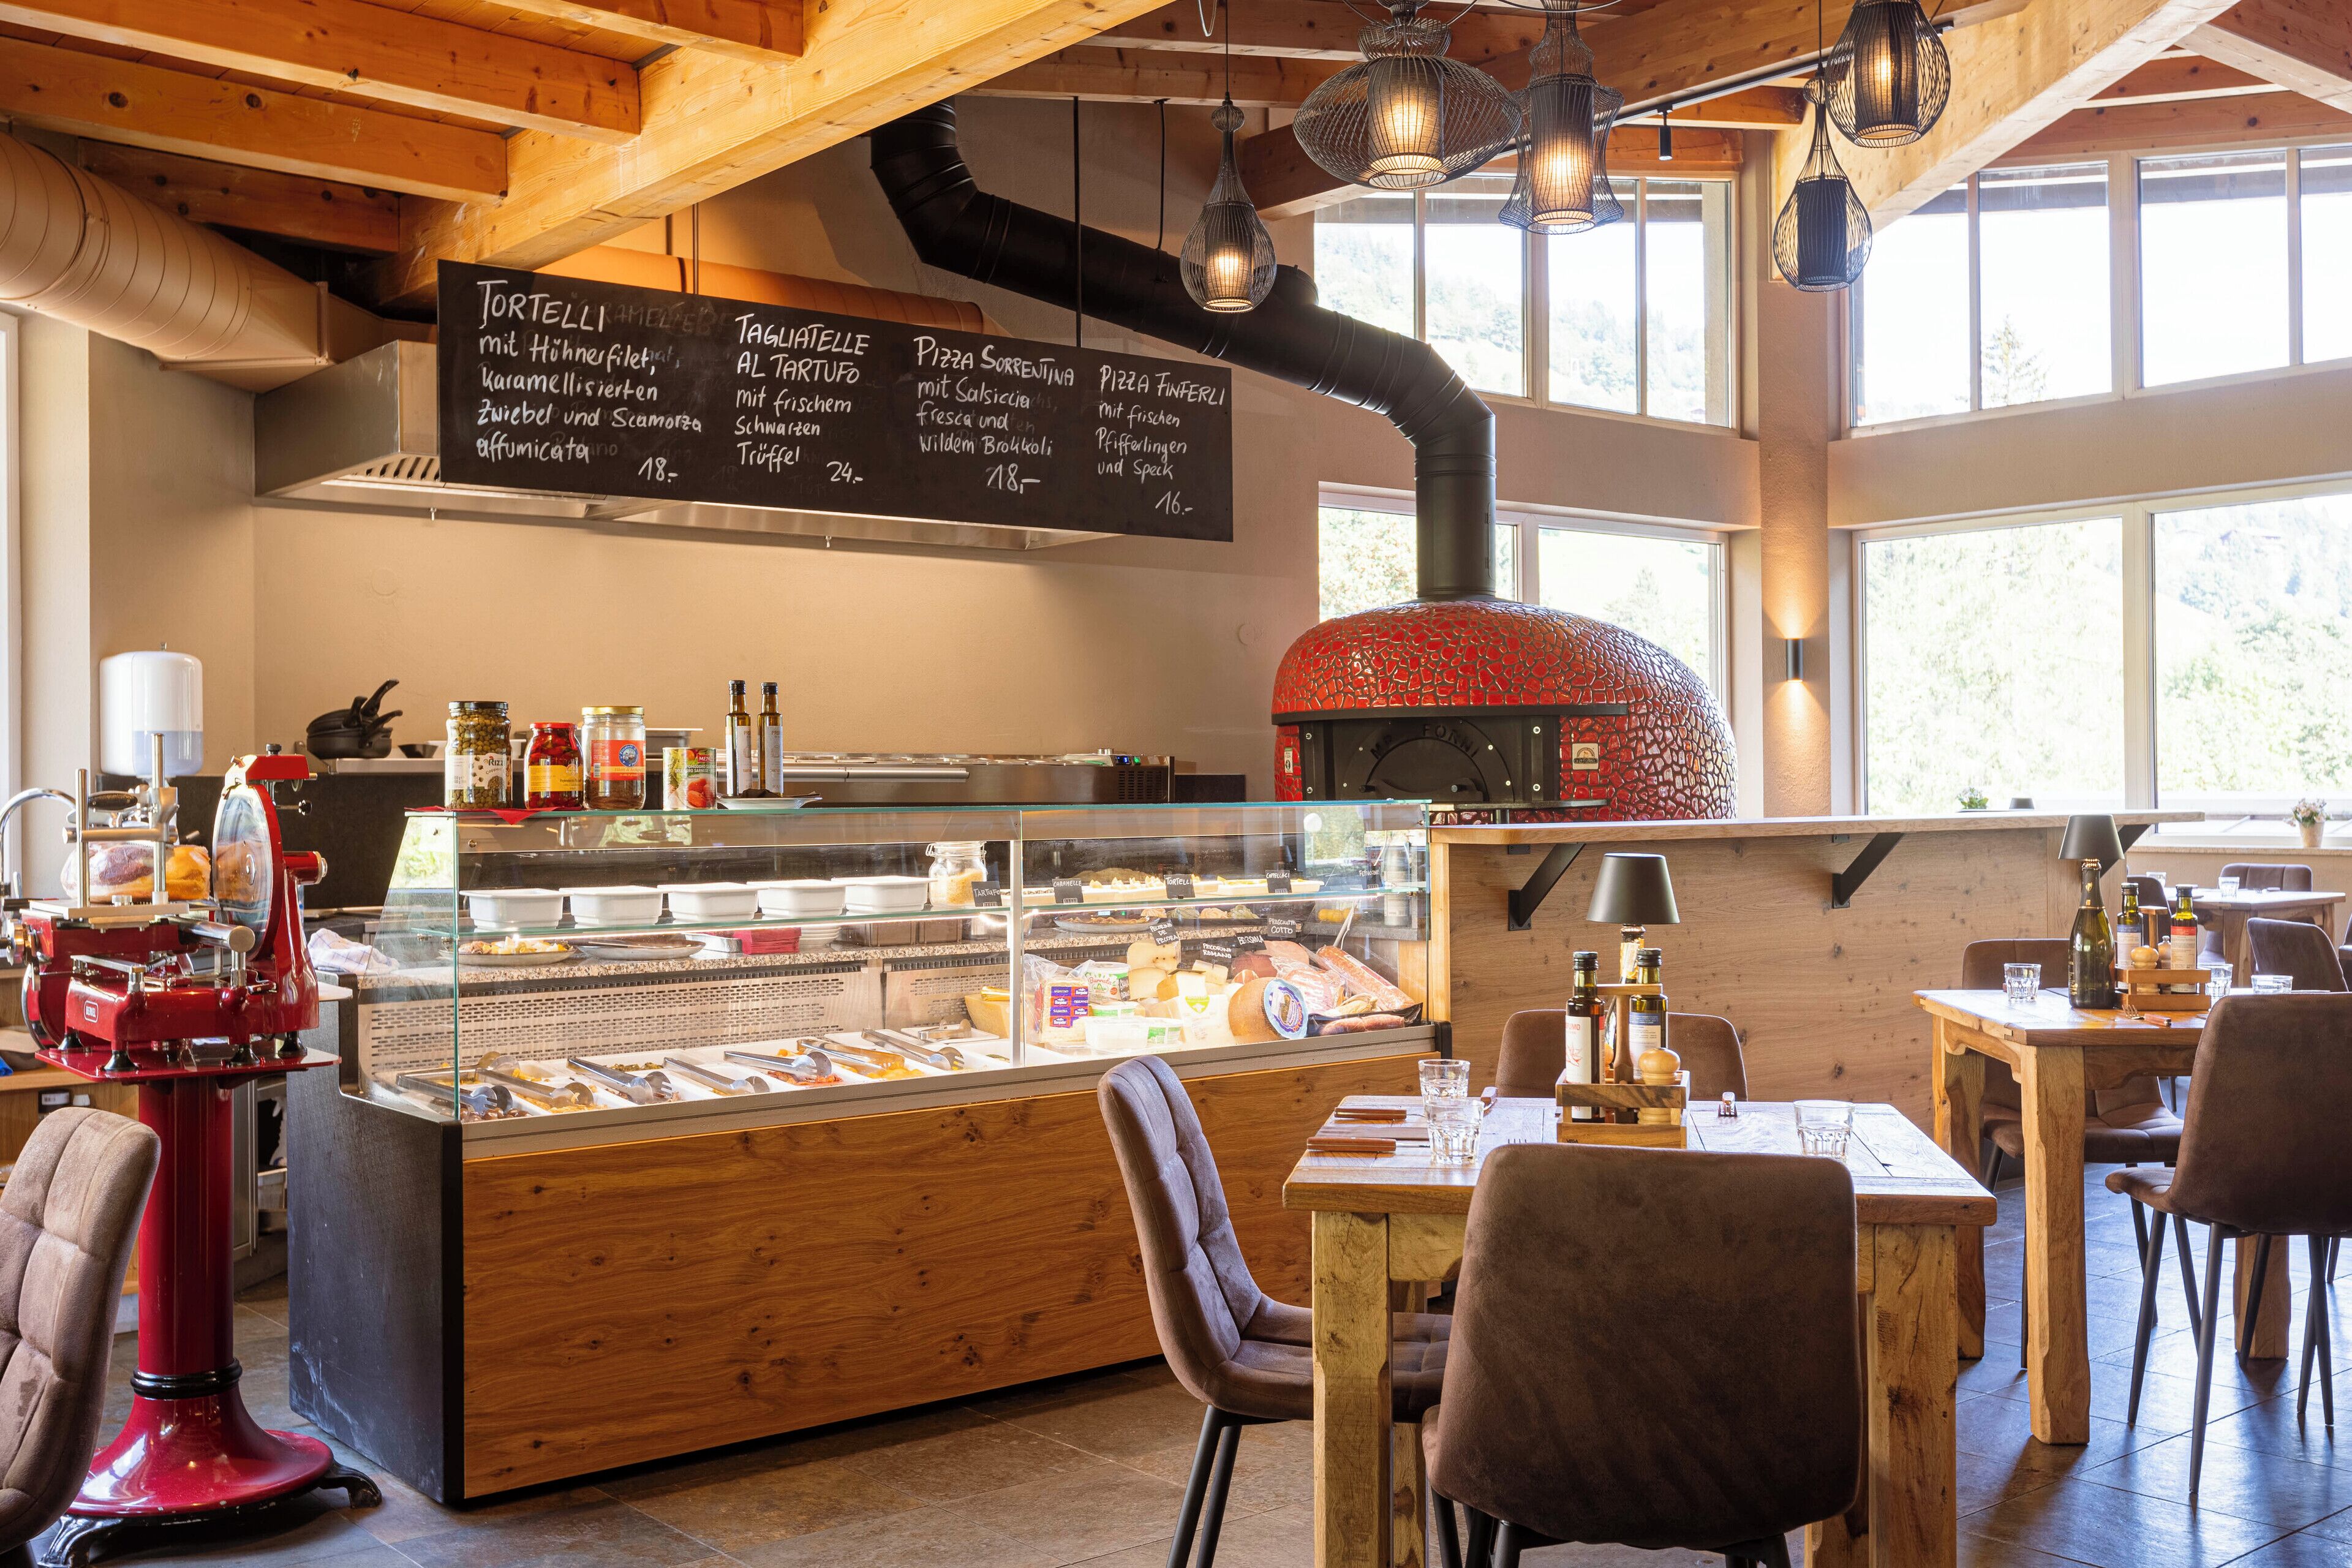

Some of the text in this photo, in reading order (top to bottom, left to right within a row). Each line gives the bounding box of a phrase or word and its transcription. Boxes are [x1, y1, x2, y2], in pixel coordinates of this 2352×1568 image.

[477, 280, 605, 333] TORTELLI
[735, 313, 870, 355] TAGLIATELLE
[480, 330, 519, 356] mit
[529, 333, 655, 375] Hühnerfilet,
[737, 351, 860, 384] AL TARTUFO
[913, 336, 1074, 386] PIZZA SORRENTINA
[918, 374, 951, 399] mit
[956, 376, 1030, 409] Salsiccia
[1099, 364, 1225, 405] PIZZA FINFERLI
[477, 398, 702, 433] Zwiebel und Scamorza
[736, 385, 851, 417] mit frischem
[1099, 402, 1180, 429] mit frischen
[979, 412, 1009, 431] und
[476, 431, 590, 464] affumicata
[737, 441, 800, 473] Trüffel
[981, 435, 1054, 456] Brokkoli
[1095, 426, 1188, 464] Pfifferlingen
[1098, 458, 1174, 484] und Speck
[973, 888, 1000, 897] TARTUFO
[1165, 876, 1193, 886] TORTELLI
[1271, 925, 1293, 934] COTTO
[1203, 950, 1232, 959] ROMANO
